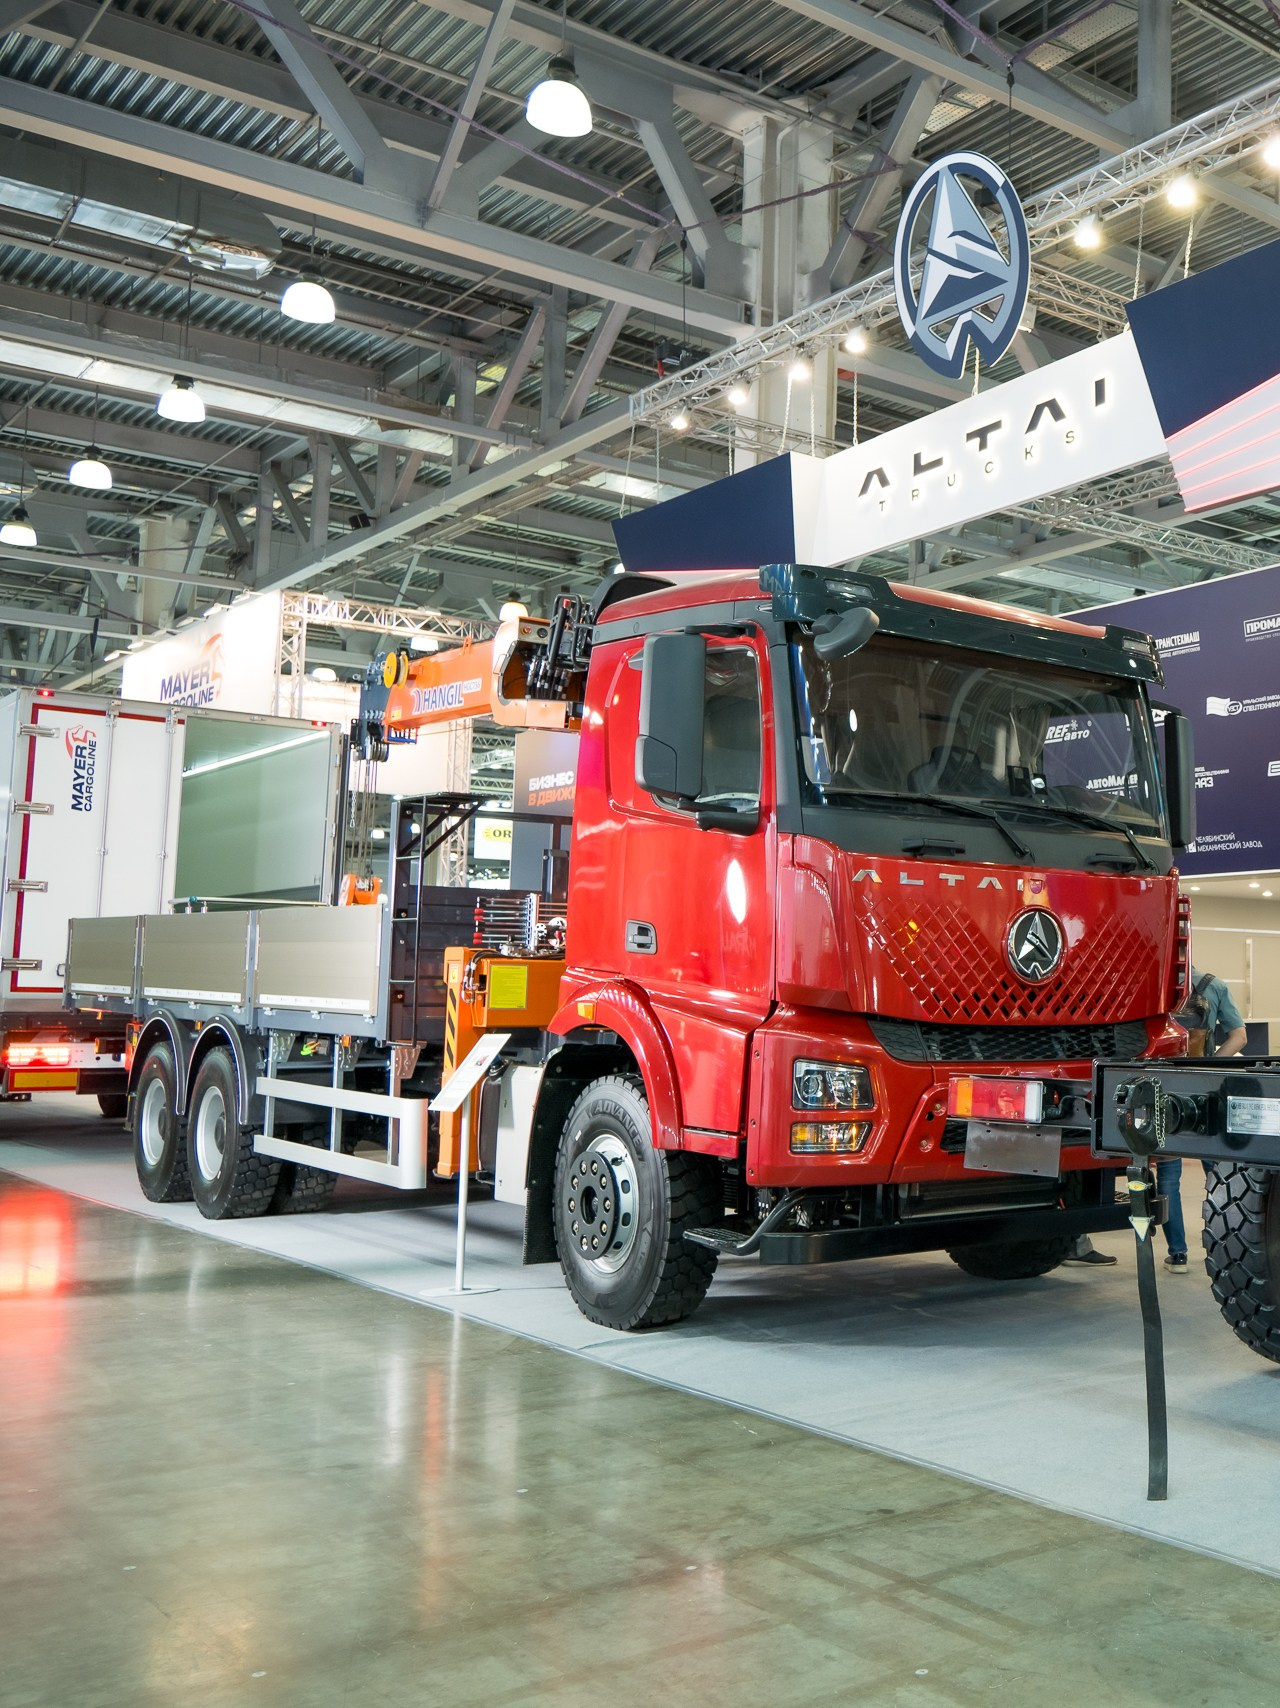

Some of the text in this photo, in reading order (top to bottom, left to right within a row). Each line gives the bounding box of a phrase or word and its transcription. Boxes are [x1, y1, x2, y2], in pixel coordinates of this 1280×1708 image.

[858, 378, 1106, 498] ALTAI
[878, 430, 1076, 513] TRUCKS
[160, 661, 211, 701] MAYER
[422, 683, 463, 713] HANGIL
[71, 744, 87, 811] MAYER
[84, 740, 97, 812] CARGOLINE
[528, 771, 574, 792] БИЗНЕС
[536, 786, 576, 807] ДВИЖ
[1197, 840, 1263, 853] МЕХАНИЧЕСКИЙ ЗАВОД
[852, 868, 1025, 892] ALTAI
[594, 1099, 643, 1147] ADVANCE
